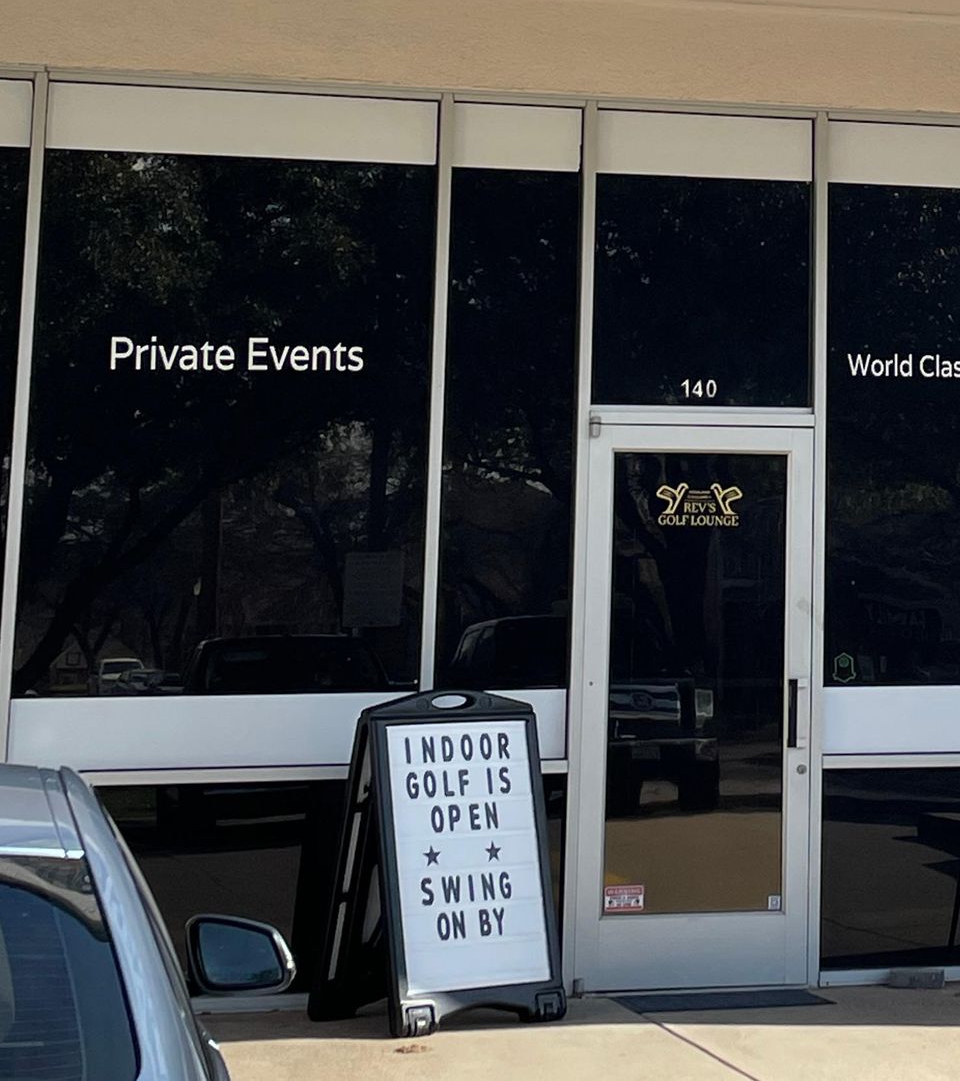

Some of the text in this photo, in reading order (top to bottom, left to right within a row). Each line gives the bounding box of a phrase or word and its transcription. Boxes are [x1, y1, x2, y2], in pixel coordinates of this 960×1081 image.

[110, 335, 364, 372] Private Events
[847, 353, 913, 377] World
[681, 378, 717, 398] 140
[657, 514, 739, 527] GOLF LOUNGE
[683, 502, 717, 514] REV'S
[404, 732, 511, 764] INDOOR
[406, 766, 512, 800] GOLF IS
[431, 801, 499, 833] OPEN
[420, 871, 512, 906] SWING
[437, 907, 505, 941] ON BY
